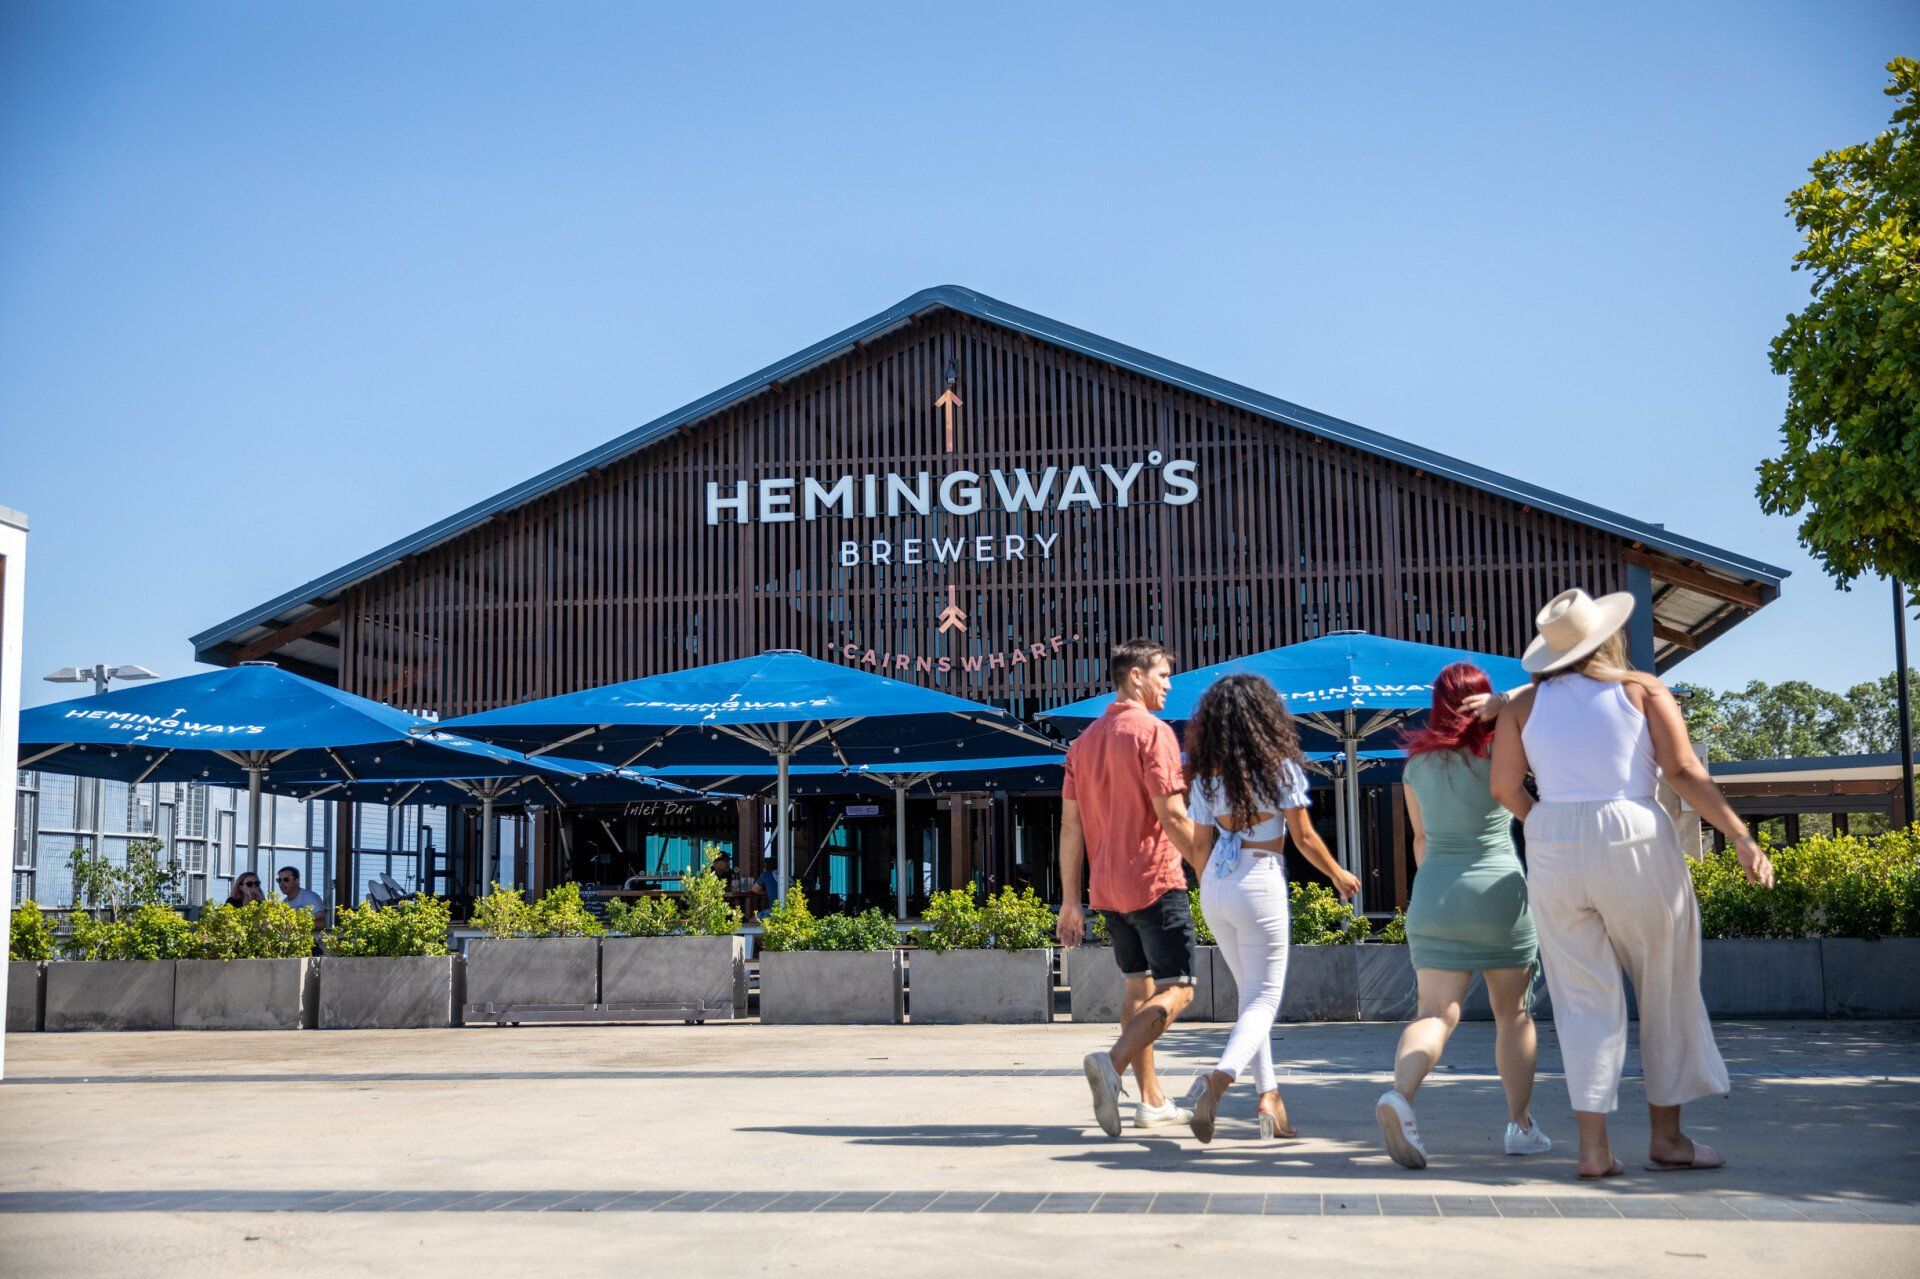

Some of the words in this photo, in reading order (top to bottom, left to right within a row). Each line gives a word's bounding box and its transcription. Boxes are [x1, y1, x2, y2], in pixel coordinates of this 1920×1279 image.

[841, 532, 1059, 567] BREWERY
[843, 643, 951, 672] CAIRNS
[961, 635, 1064, 672] WHARF
[64, 709, 266, 734] HEMINGWAY'S
[109, 722, 201, 737] BREWERY
[624, 802, 659, 816] Inlet
[664, 801, 693, 815] Bar
